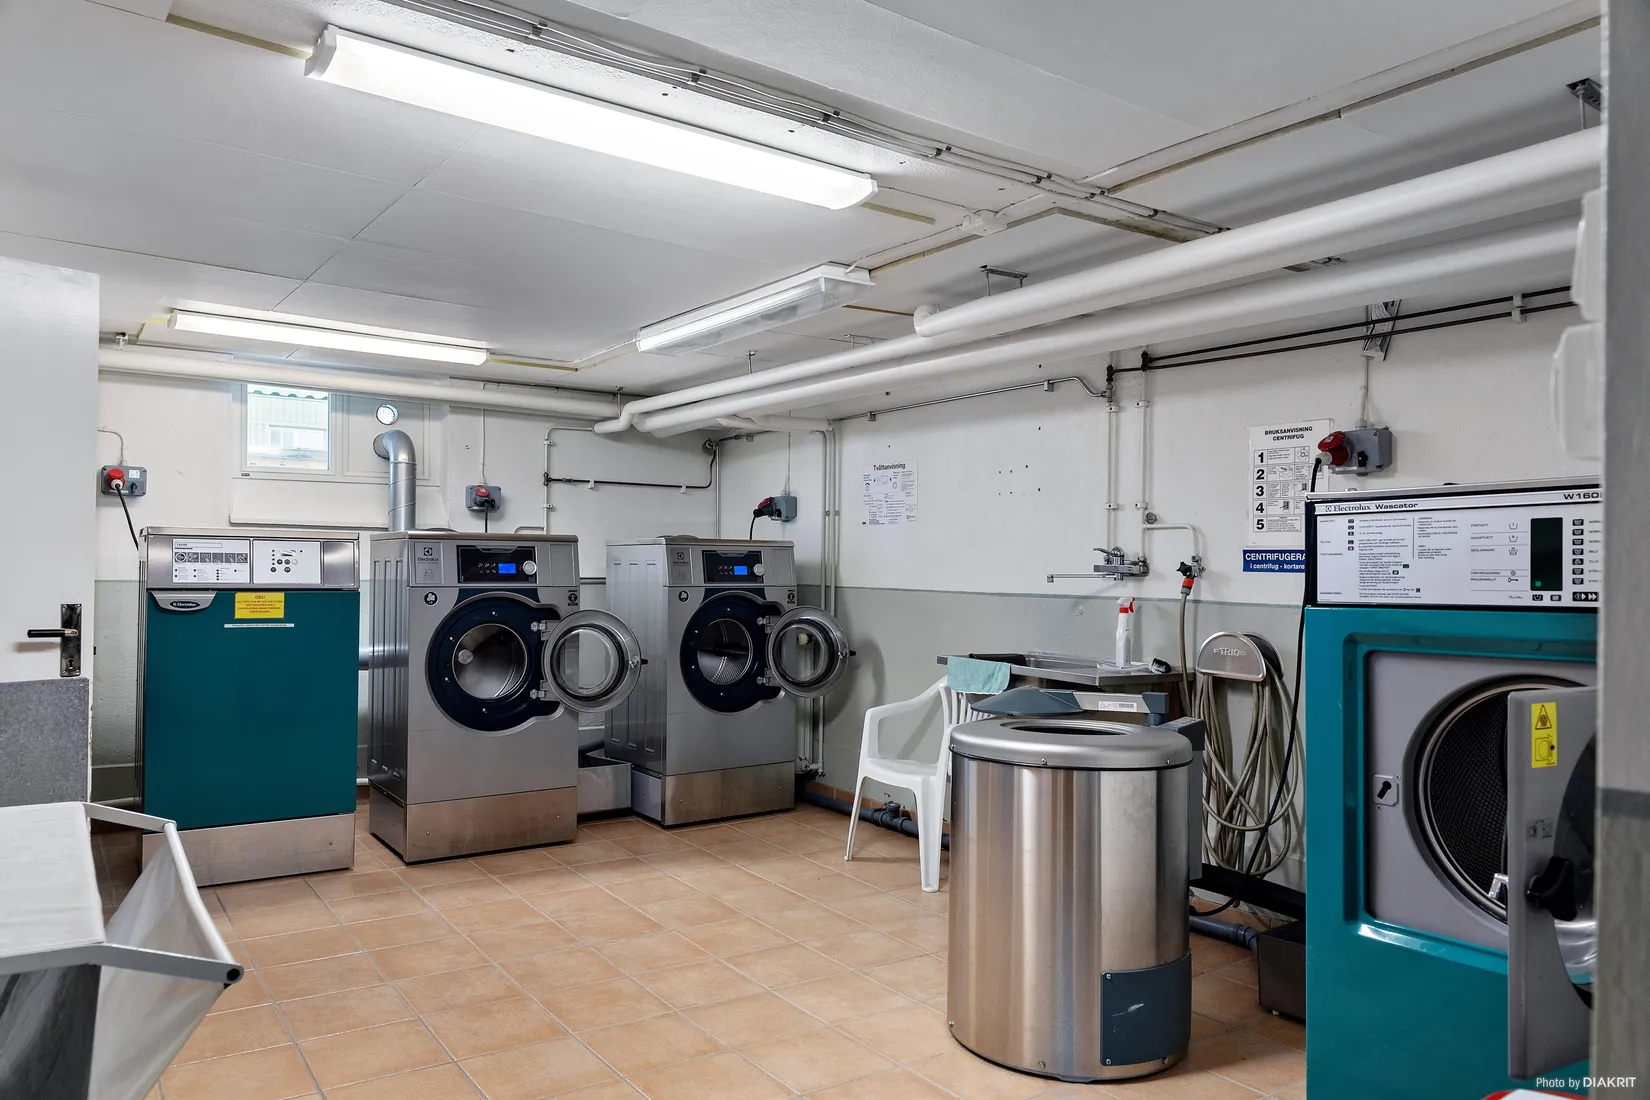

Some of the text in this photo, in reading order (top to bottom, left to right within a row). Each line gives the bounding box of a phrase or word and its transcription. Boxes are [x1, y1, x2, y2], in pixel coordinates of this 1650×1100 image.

[1264, 426, 1313, 436] BRUKSANVISNING
[1272, 433, 1304, 441] CENTRIFUG
[1258, 452, 1264, 463] 1
[1255, 469, 1265, 480] 2
[1255, 485, 1265, 497] 3
[1255, 502, 1265, 514] 4
[1333, 502, 1418, 512] Electrolux Wascator
[1256, 519, 1265, 530] 5
